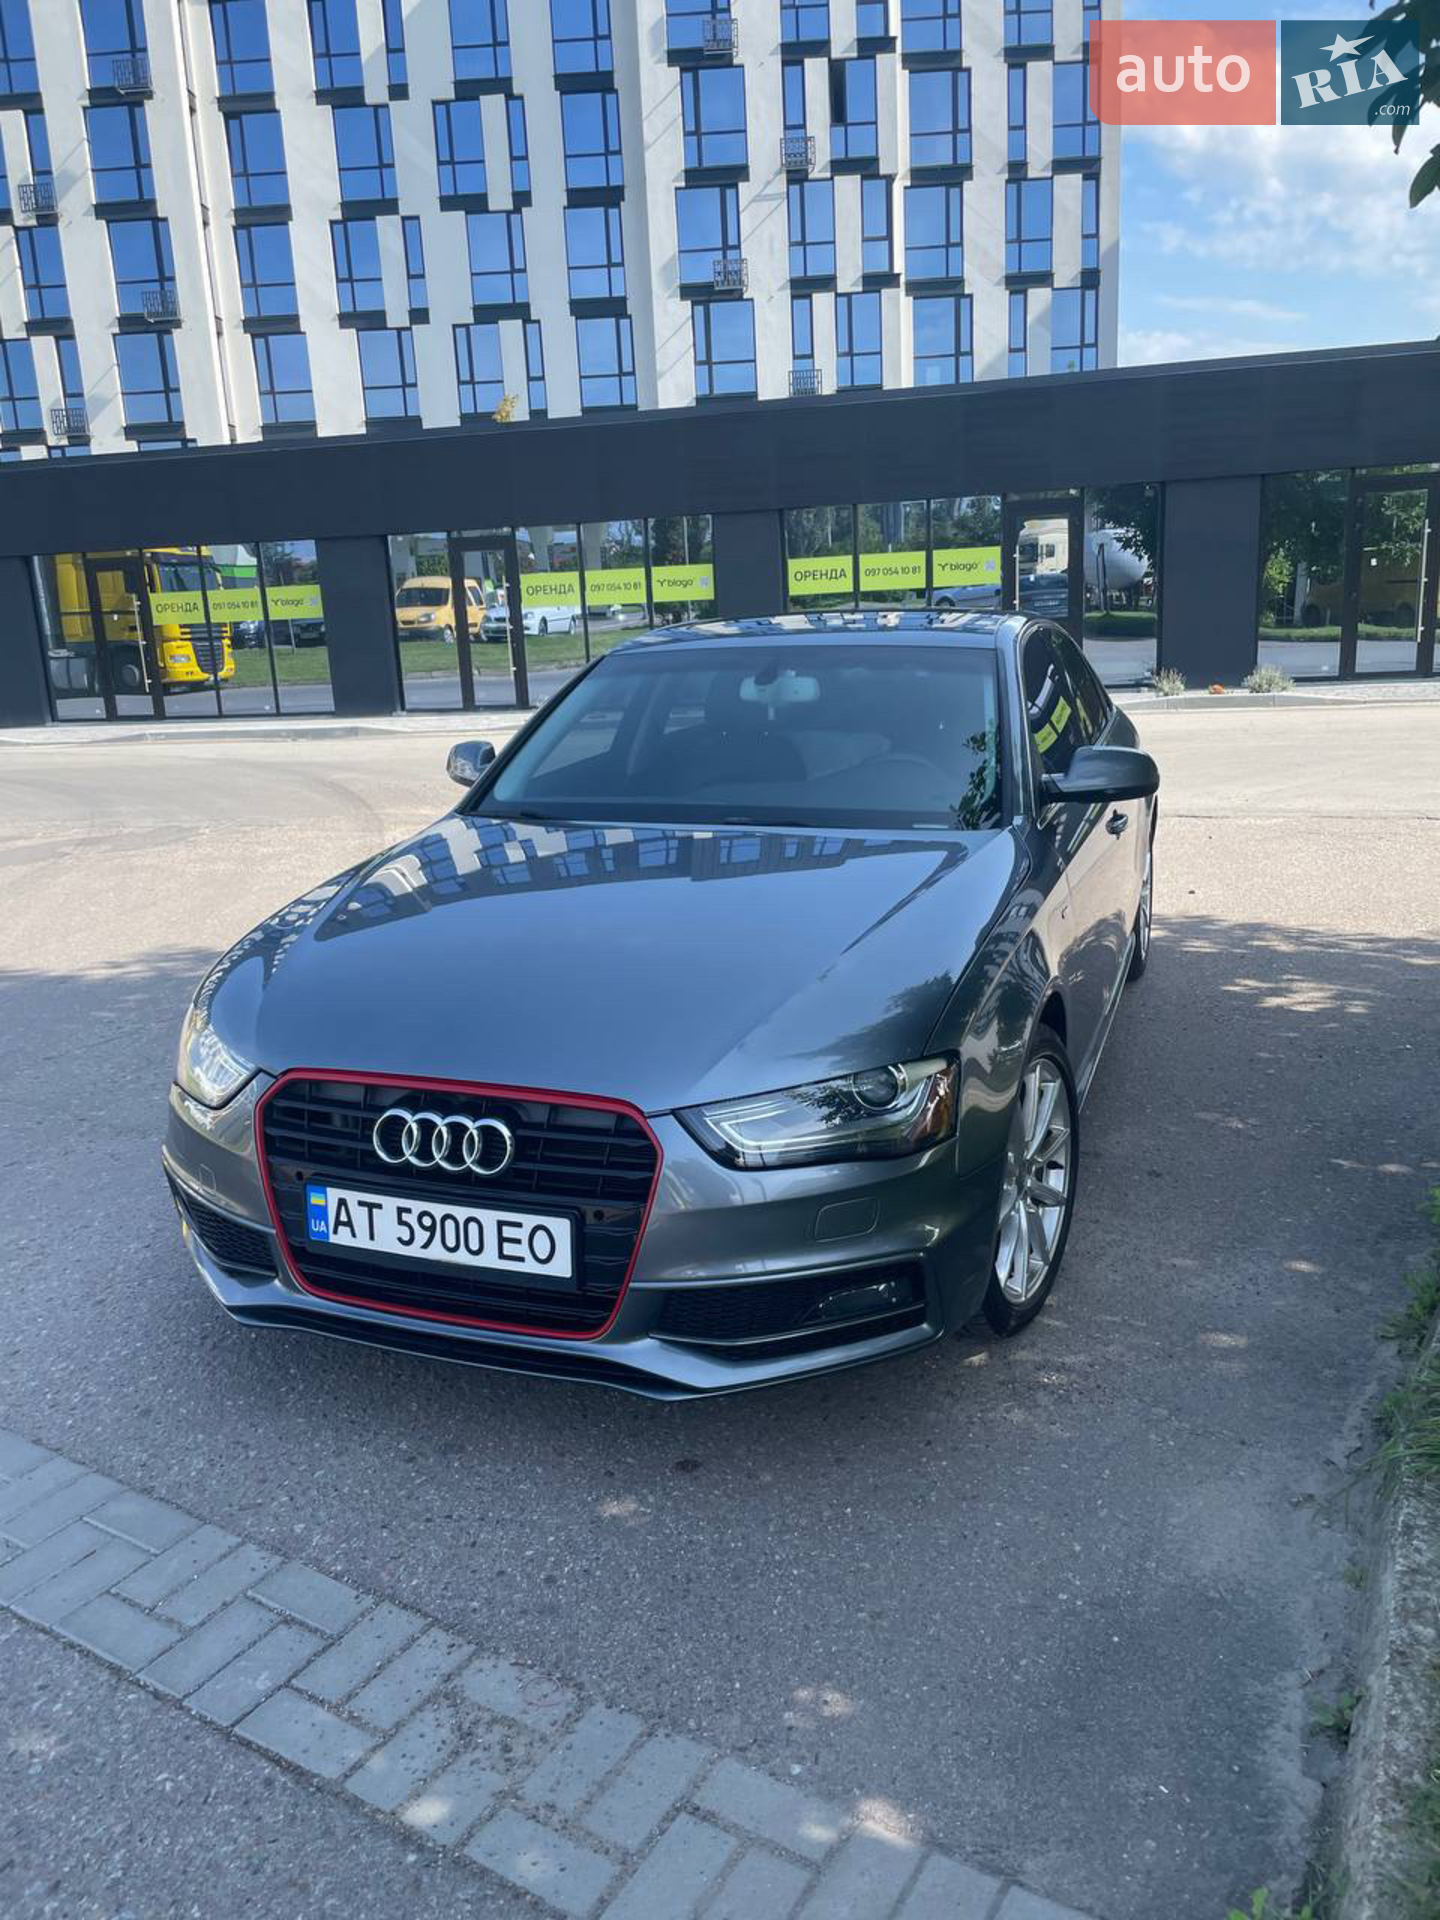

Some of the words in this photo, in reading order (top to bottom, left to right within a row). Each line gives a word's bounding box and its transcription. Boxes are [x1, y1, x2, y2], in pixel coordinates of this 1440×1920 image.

[794, 568, 847, 582] ОРЕНДА
[864, 567, 881, 577] 097
[882, 566, 900, 576] 054
[901, 565, 910, 575] 10
[911, 565, 921, 575] 81
[526, 583, 575, 597] ОРЕНДА
[623, 582, 632, 591] 10
[155, 602, 199, 613] ОРЕНДА
[311, 1219, 328, 1233] UA
[332, 1198, 383, 1241] AT
[396, 1206, 484, 1256] 5900
[496, 1219, 556, 1265] EO
